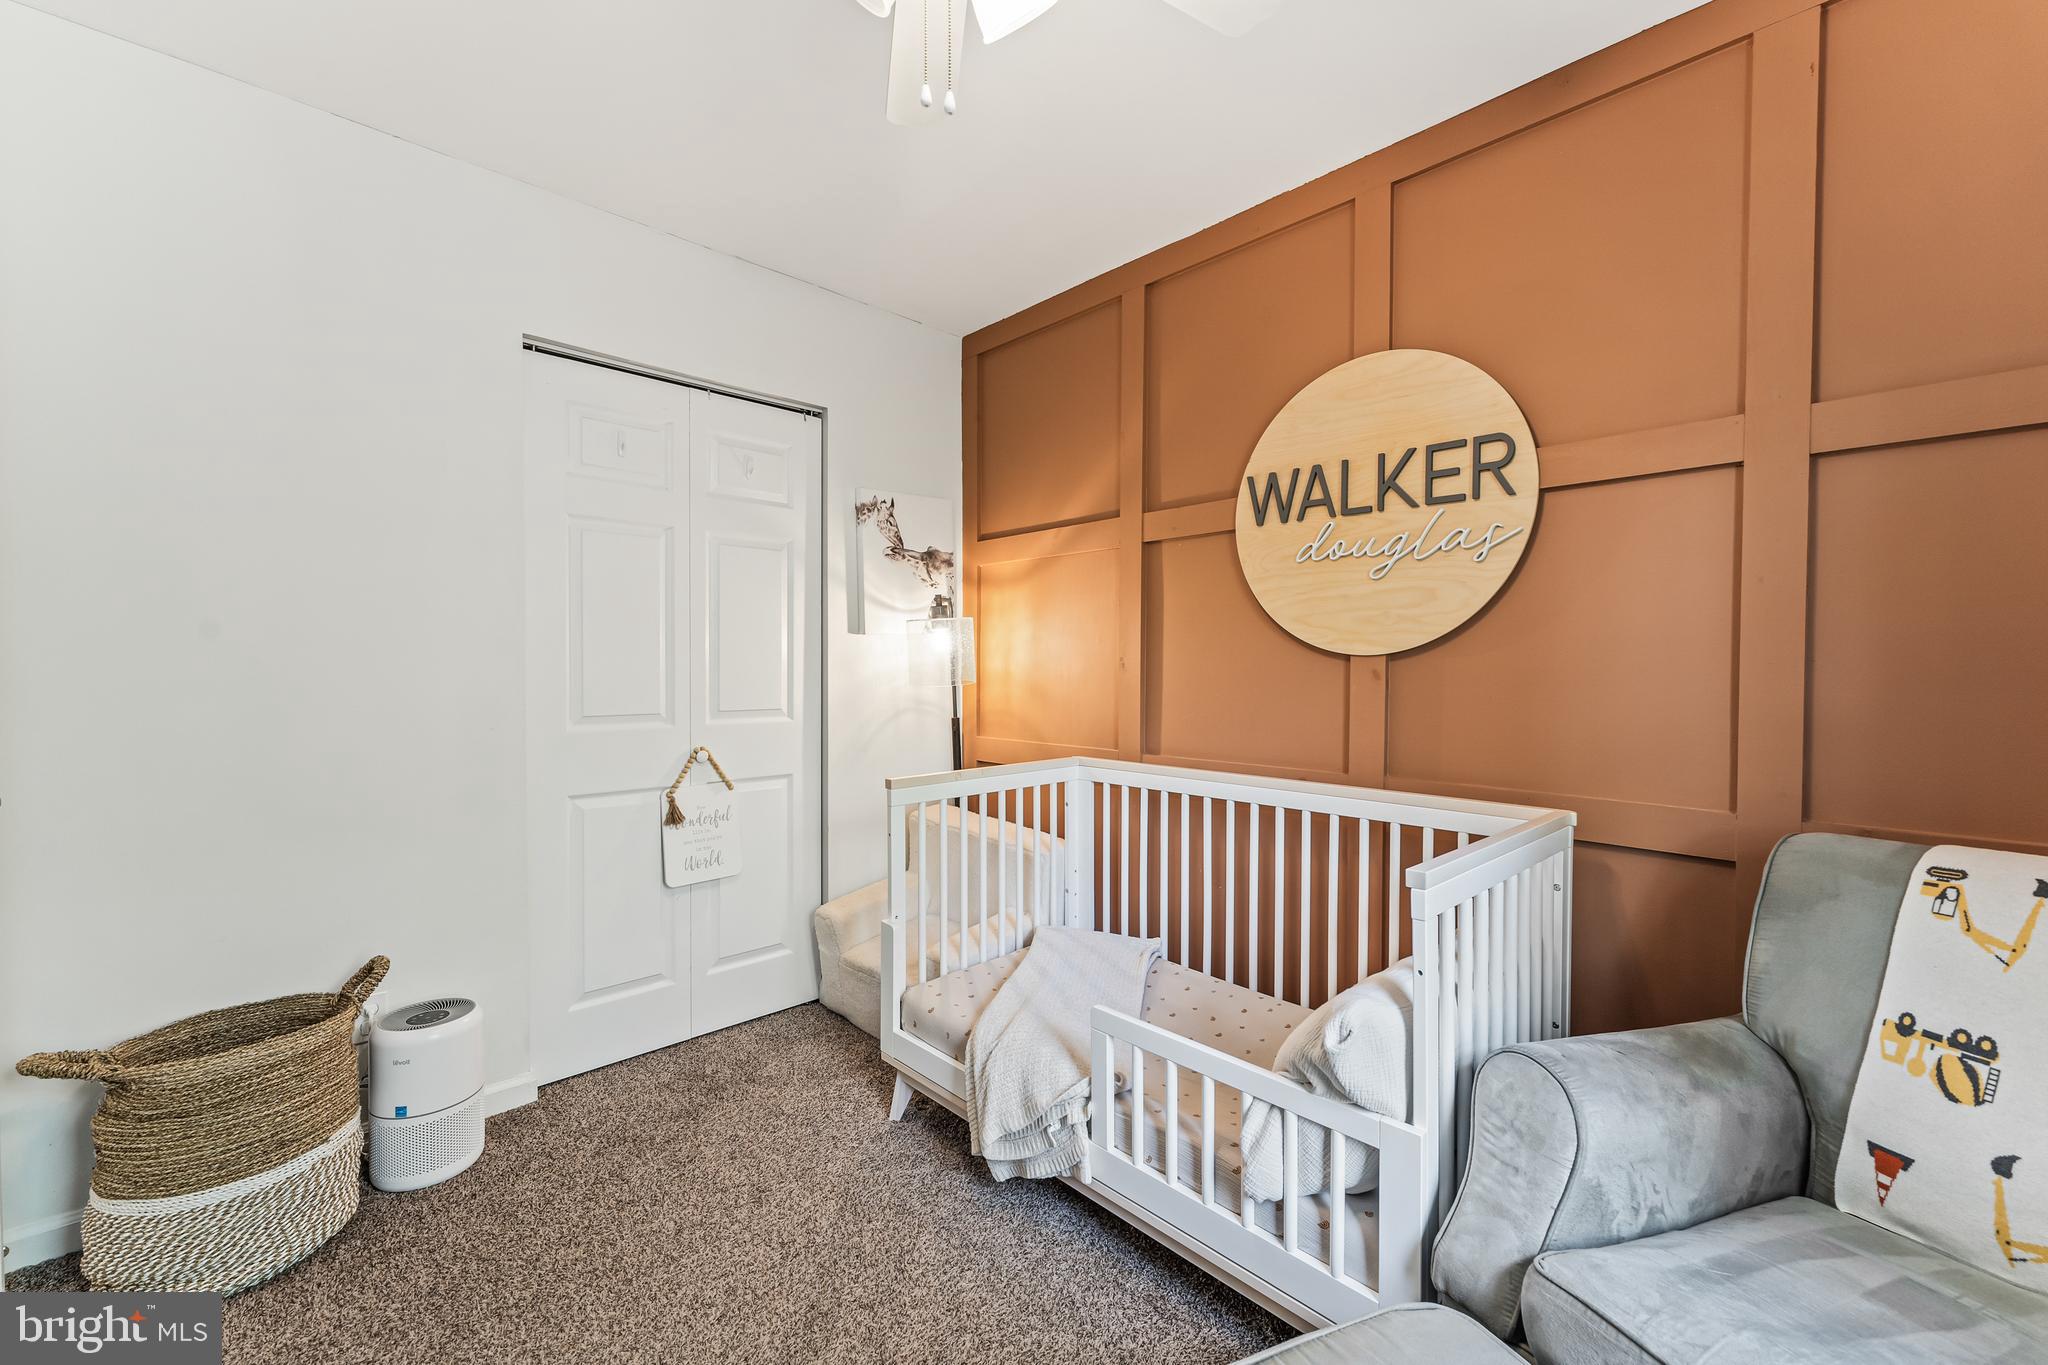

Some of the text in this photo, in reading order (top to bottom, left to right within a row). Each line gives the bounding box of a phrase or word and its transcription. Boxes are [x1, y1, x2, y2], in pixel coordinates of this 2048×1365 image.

[1247, 432, 1517, 527] WALKER
[1295, 508, 1524, 580] douglas
[669, 804, 731, 829] nderful
